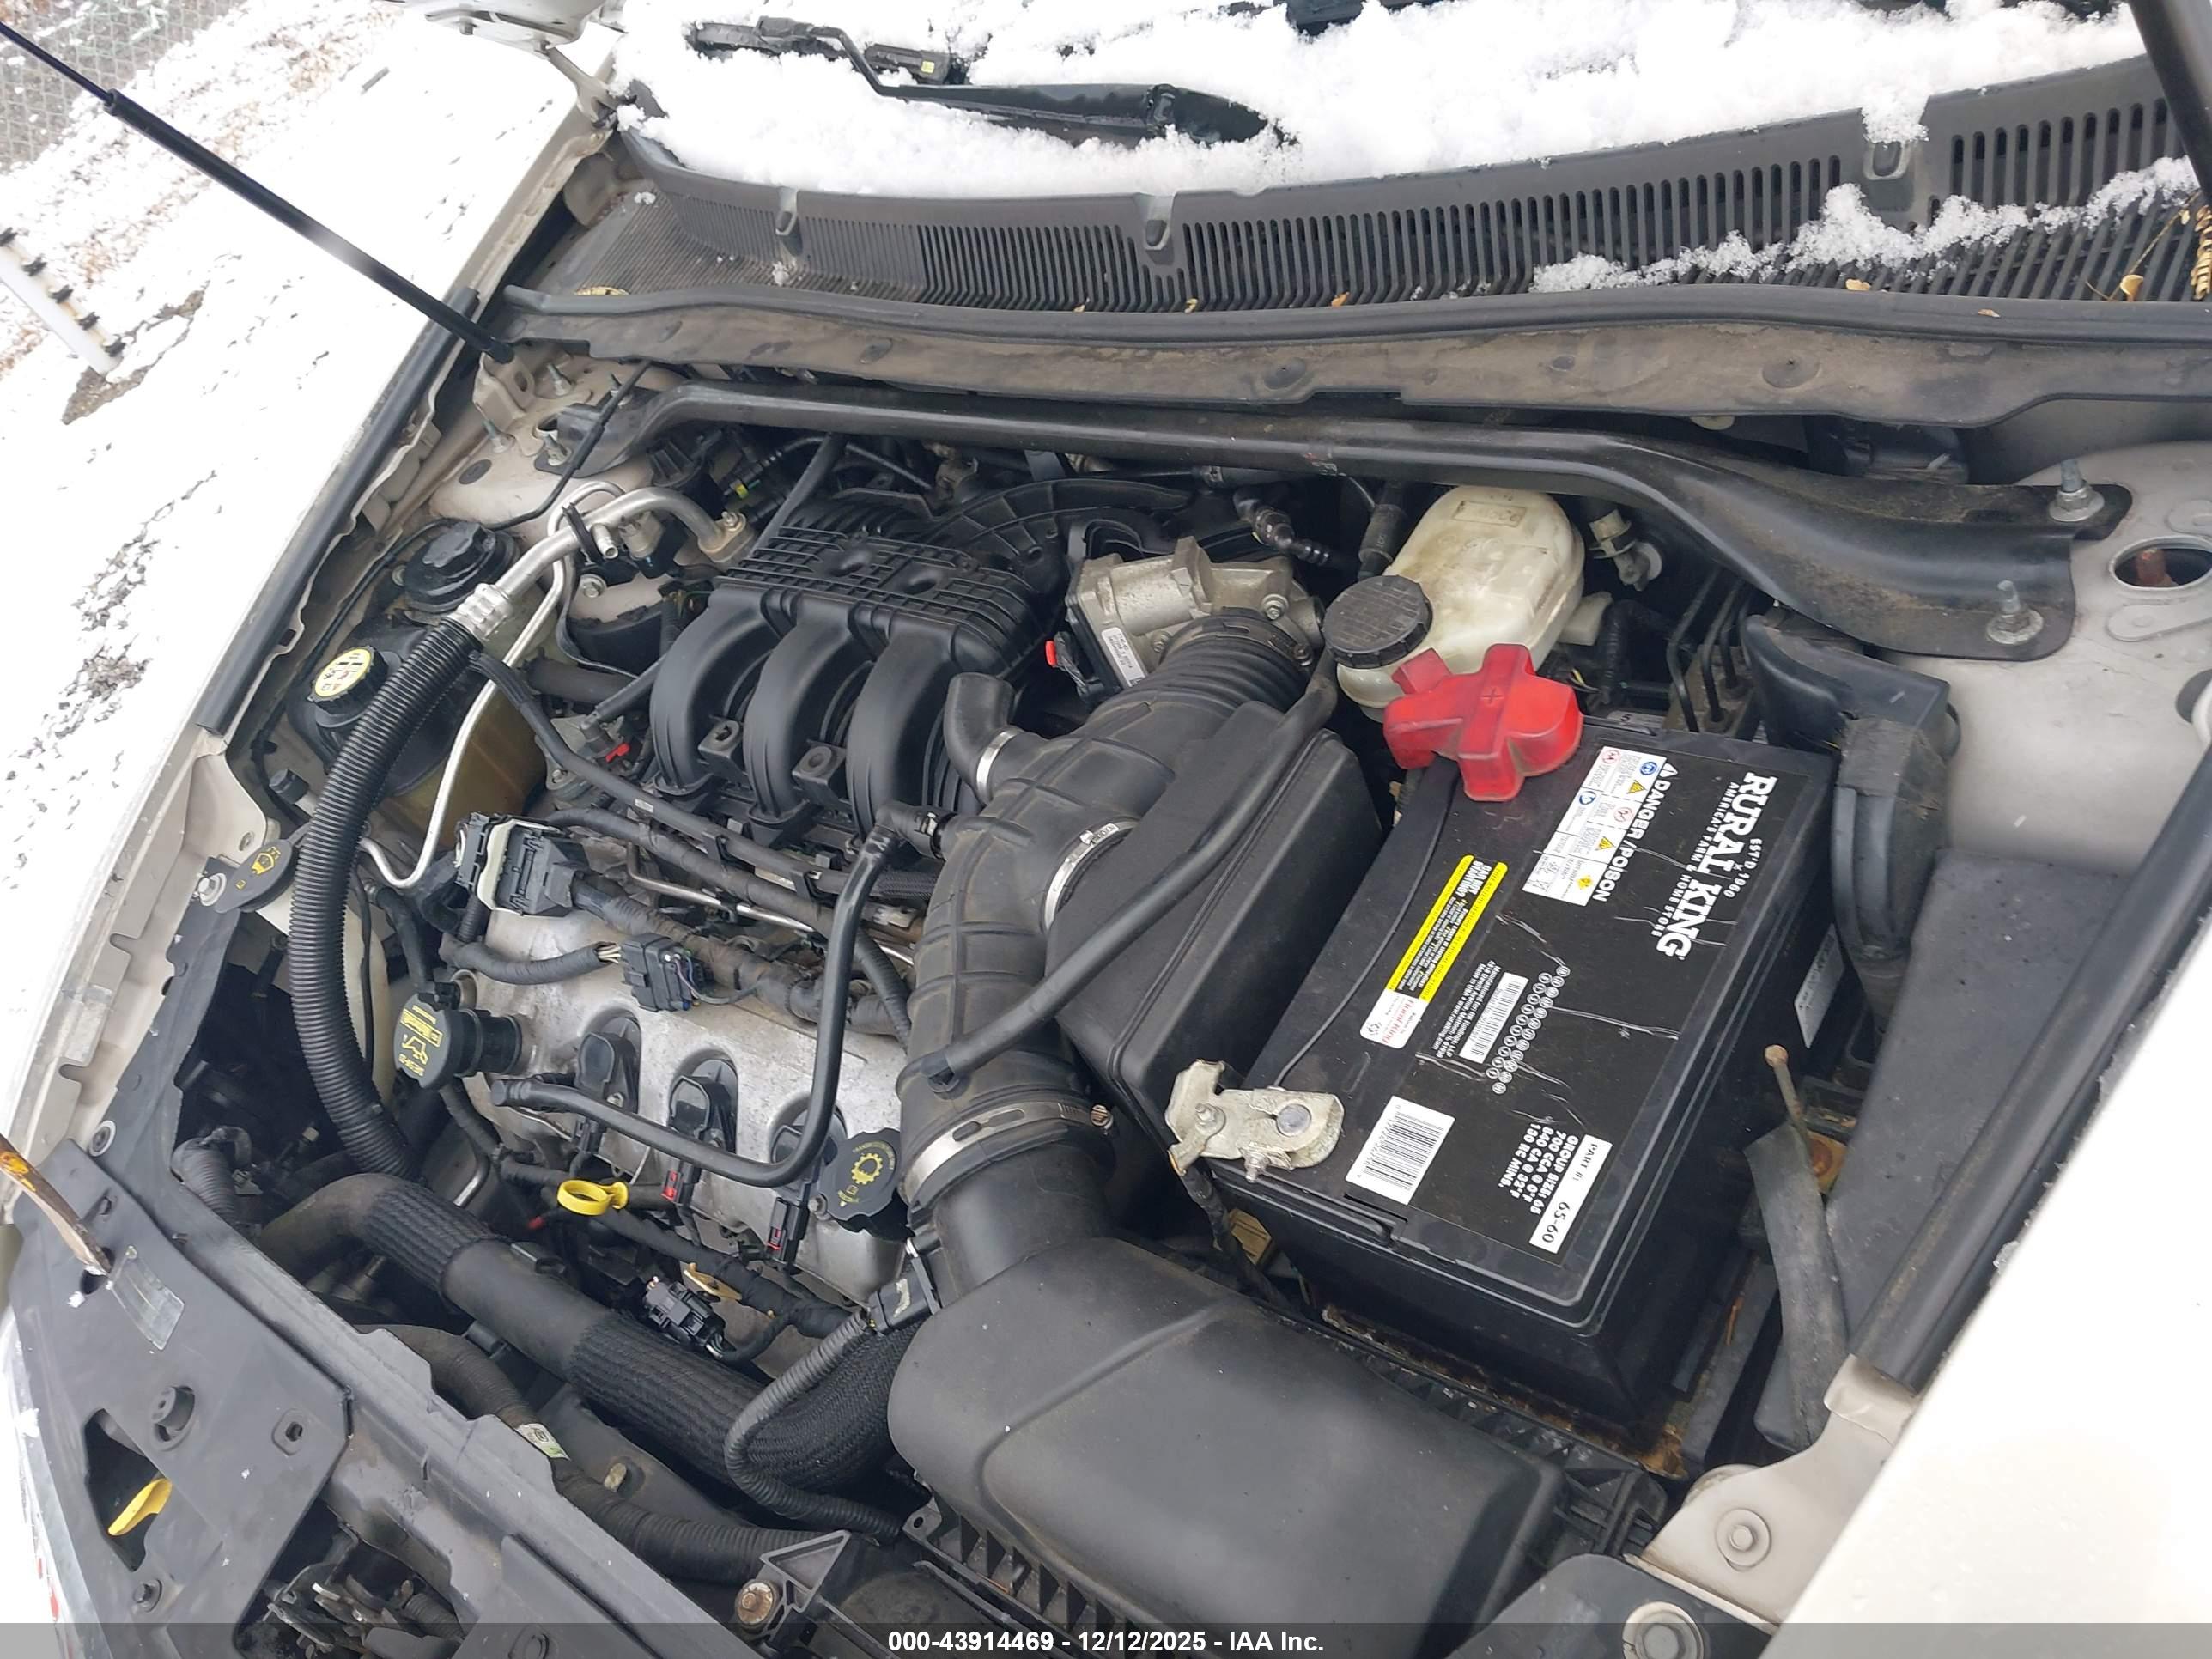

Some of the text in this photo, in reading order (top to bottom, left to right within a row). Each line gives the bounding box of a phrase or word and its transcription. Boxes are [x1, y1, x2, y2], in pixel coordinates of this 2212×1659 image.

[1626, 779, 1672, 839] DANGER
[1705, 782, 1741, 833] AMERICA'S
[1689, 834, 1712, 862] FARM
[1655, 770, 1780, 957] RURAL KING
[1723, 838, 1763, 899] EST'D 1960
[1454, 860, 1484, 897] STARTING?
[1467, 865, 1492, 895] CAR NOT
[1668, 874, 1692, 902] HOME
[1650, 905, 1671, 937] STORE
[1535, 1126, 1553, 1147] 840
[1547, 1131, 1565, 1152] 700
[1516, 1144, 1530, 1158] RC
[1527, 1147, 1542, 1163] CA
[1535, 1152, 1554, 1174] CCA
[1579, 1143, 1598, 1168] PART
[1521, 1163, 1534, 1173] @
[1529, 1134, 1578, 1214] GROUP SIZE: 65
[1530, 1173, 1543, 1184] @
[1540, 1200, 1571, 1243] 65-60
